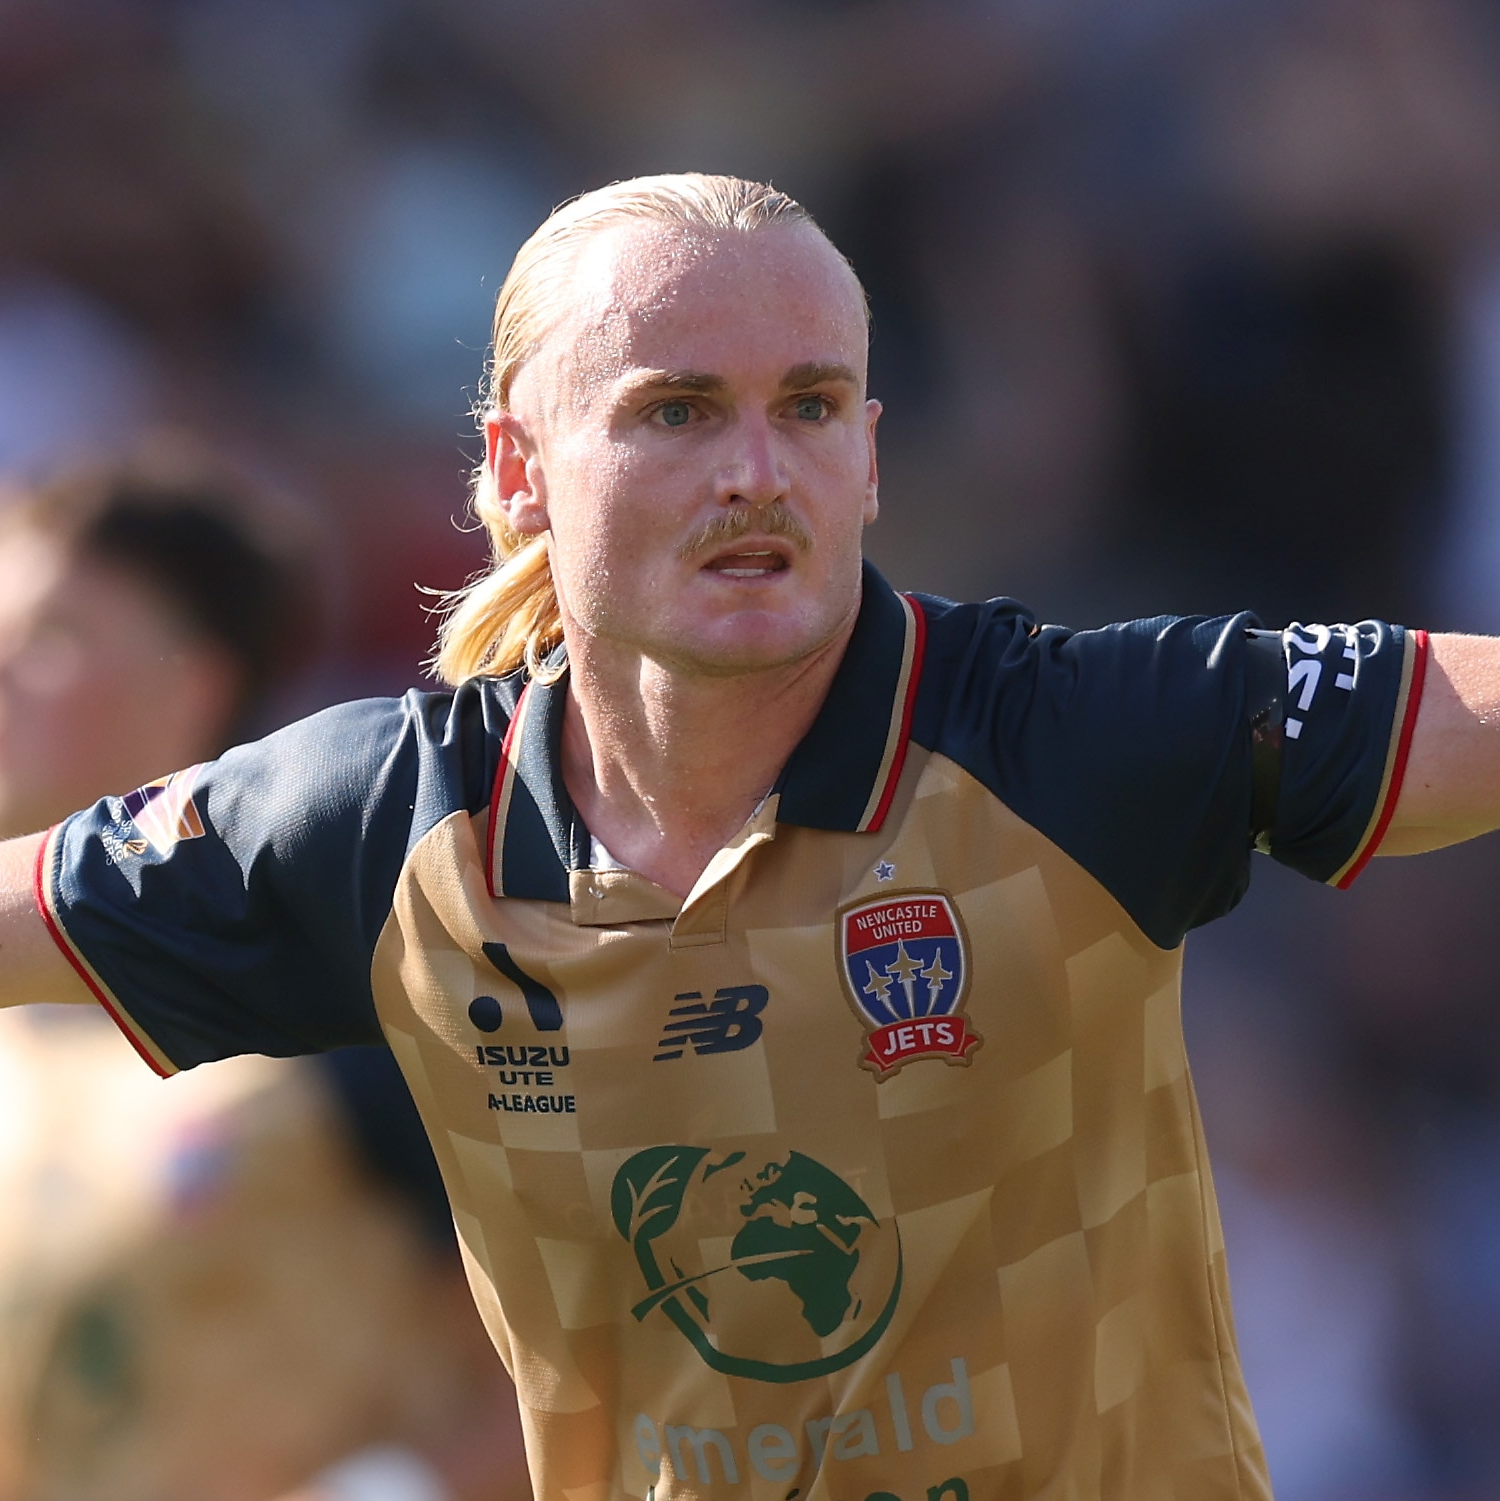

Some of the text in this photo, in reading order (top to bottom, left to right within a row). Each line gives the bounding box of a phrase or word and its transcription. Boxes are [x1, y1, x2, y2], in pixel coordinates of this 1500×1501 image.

[855, 905, 937, 931] NEWCASTLE
[872, 920, 923, 940] UNITED
[883, 1022, 955, 1056] JETS
[476, 1045, 570, 1068] ISUZU
[499, 1070, 554, 1086] UTE
[488, 1093, 576, 1114] A-LEAGUE
[634, 1356, 976, 1485] emerald
